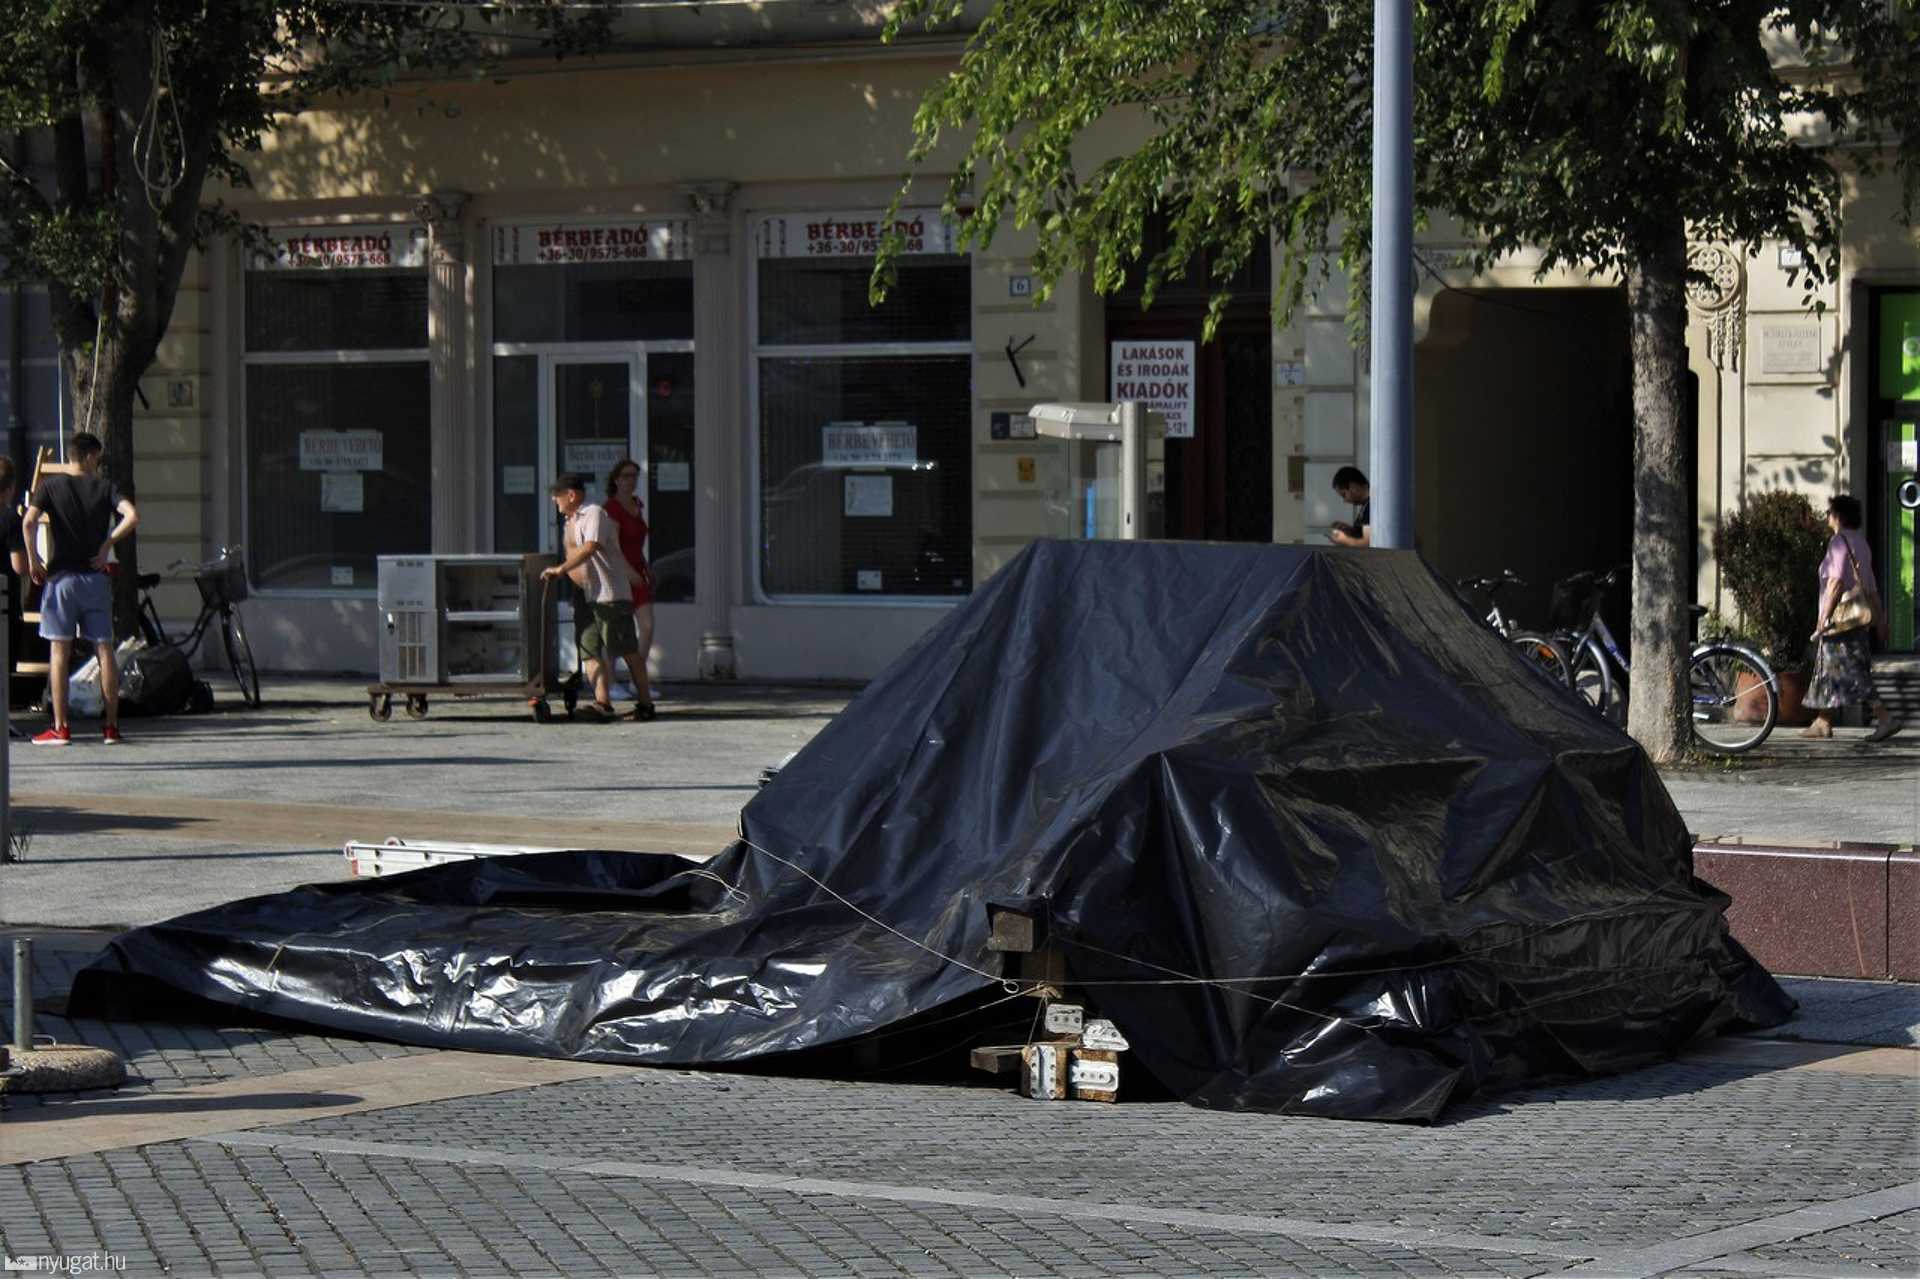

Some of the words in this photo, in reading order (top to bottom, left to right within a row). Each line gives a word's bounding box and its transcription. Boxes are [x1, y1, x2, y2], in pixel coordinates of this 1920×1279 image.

[287, 230, 391, 253] BÉRBEADÓ
[537, 224, 648, 247] BÉRBEADÓ
[1122, 346, 1184, 360] LAKÁSOK
[1117, 360, 1133, 377] ÉS
[1138, 362, 1189, 377] IRODÁK
[1117, 378, 1189, 399] KIADÓK
